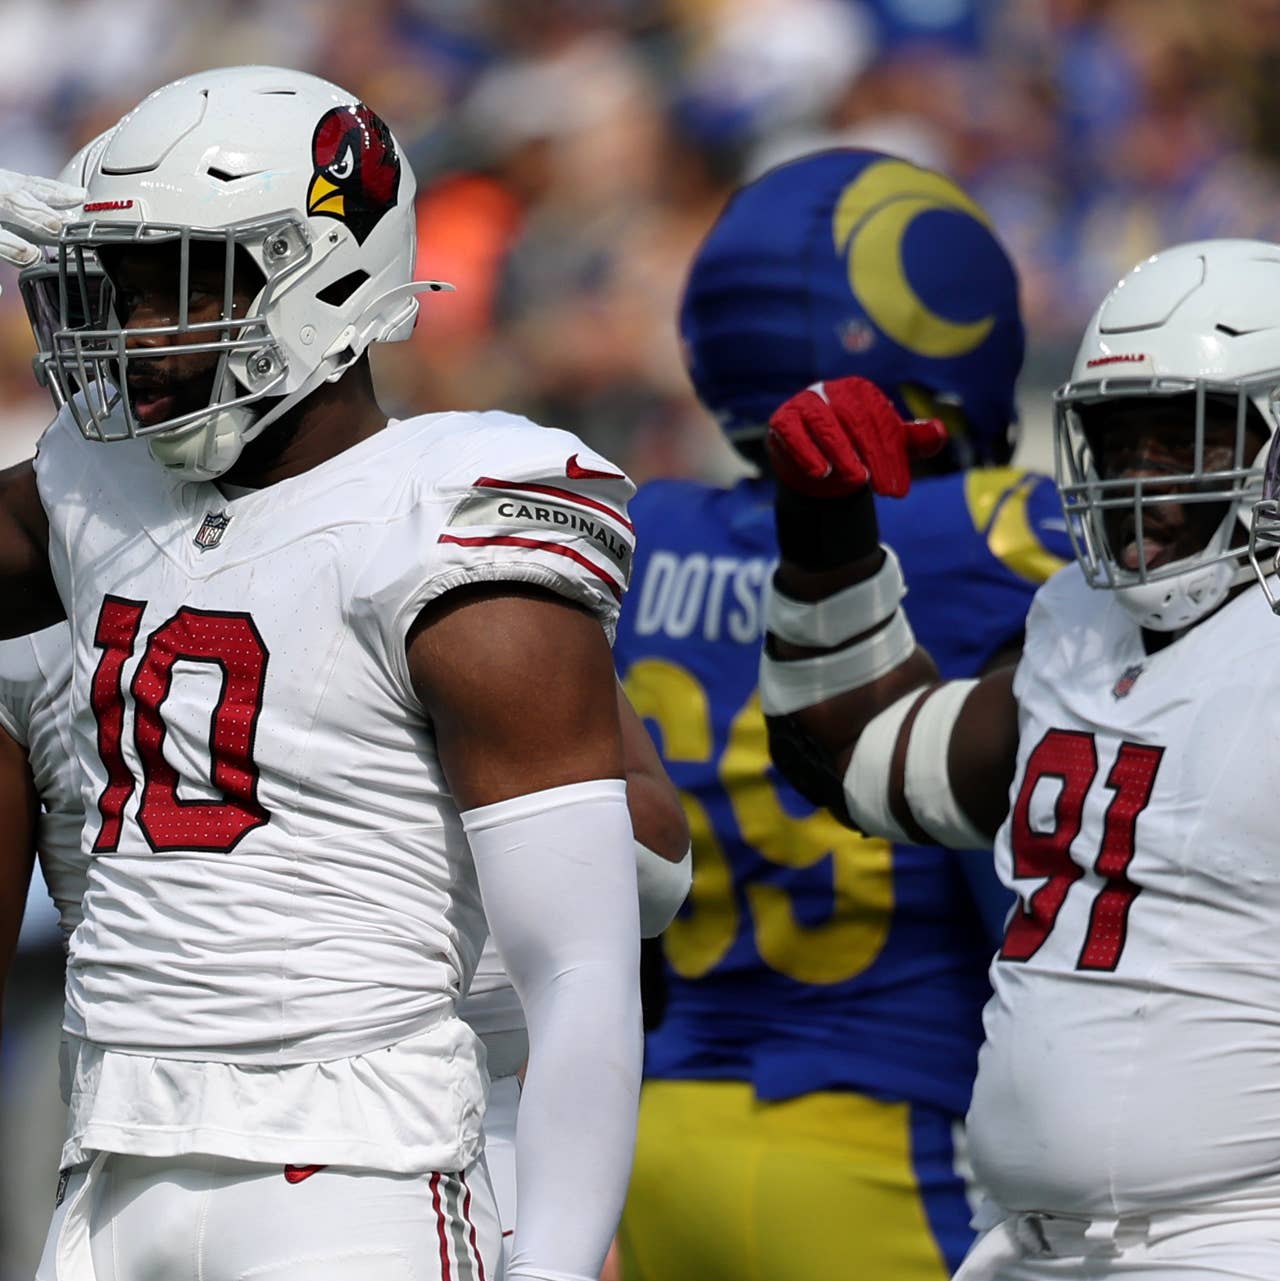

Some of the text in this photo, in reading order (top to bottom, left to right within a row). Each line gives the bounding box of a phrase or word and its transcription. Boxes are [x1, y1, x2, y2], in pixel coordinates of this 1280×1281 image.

[497, 502, 627, 561] CARDINALS
[635, 552, 780, 644] DOTS
[90, 593, 271, 855] 10
[997, 727, 1166, 973] 91
